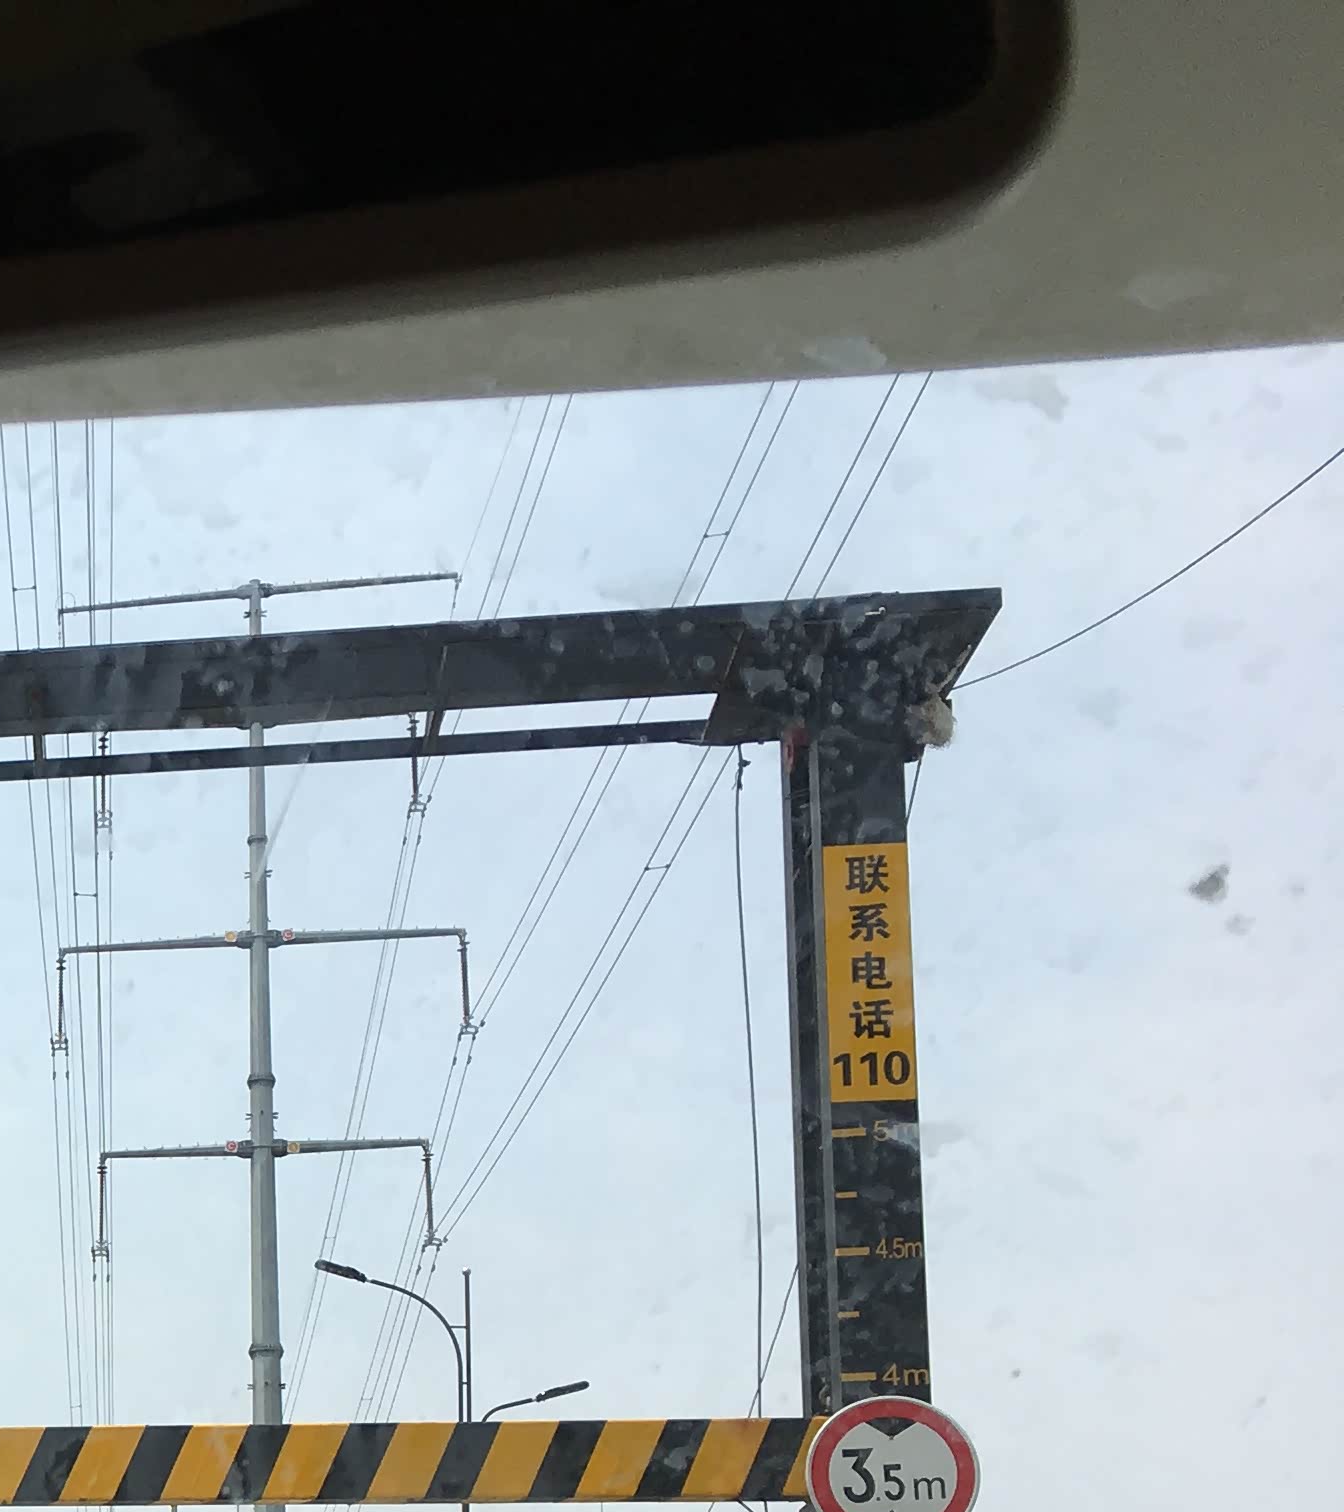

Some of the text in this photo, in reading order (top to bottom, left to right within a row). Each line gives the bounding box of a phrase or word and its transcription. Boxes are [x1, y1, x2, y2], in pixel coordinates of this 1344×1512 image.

[845, 855, 894, 1038] 联系电话
[833, 1051, 910, 1086] 110
[875, 1237, 923, 1260] 4.5m
[882, 1363, 929, 1386] 4m
[841, 1448, 946, 1503] 3.5m
